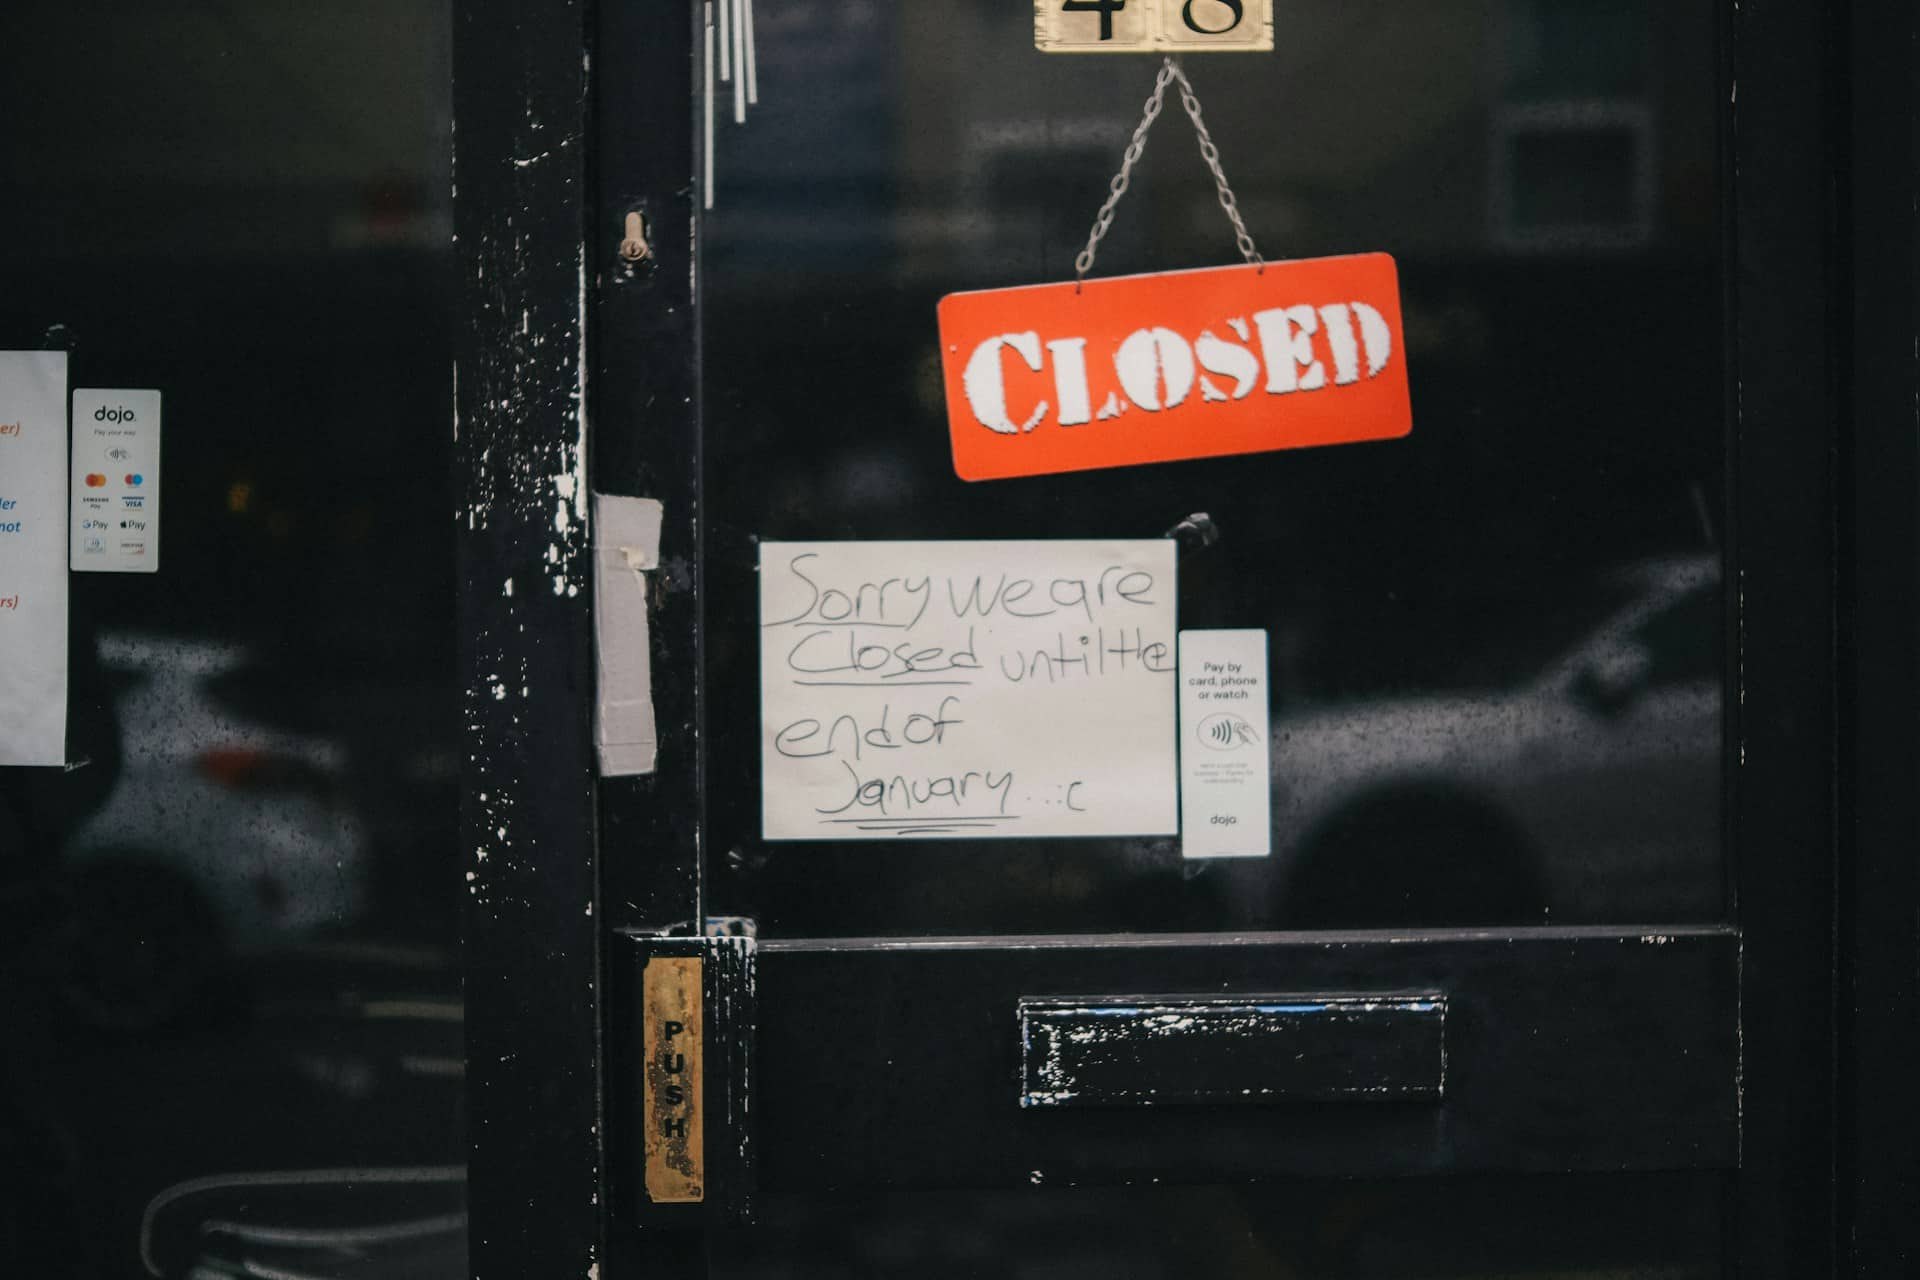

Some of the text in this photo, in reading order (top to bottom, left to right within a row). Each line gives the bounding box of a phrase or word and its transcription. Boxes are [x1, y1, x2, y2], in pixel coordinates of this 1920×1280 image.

[962, 301, 1392, 434] CLOSED
[92, 519, 108, 531] Pay
[129, 519, 145, 531] Pay
[762, 554, 930, 630] Sorry
[1050, 566, 1156, 622] are
[788, 626, 983, 678] Closed
[1000, 626, 1103, 683] until
[1188, 675, 1257, 688] card, phone
[1204, 661, 1242, 674] Pay by
[1198, 689, 1248, 699] or watch
[776, 696, 964, 759] end of
[815, 760, 1013, 815] January
[664, 1021, 685, 1138] PUSH
